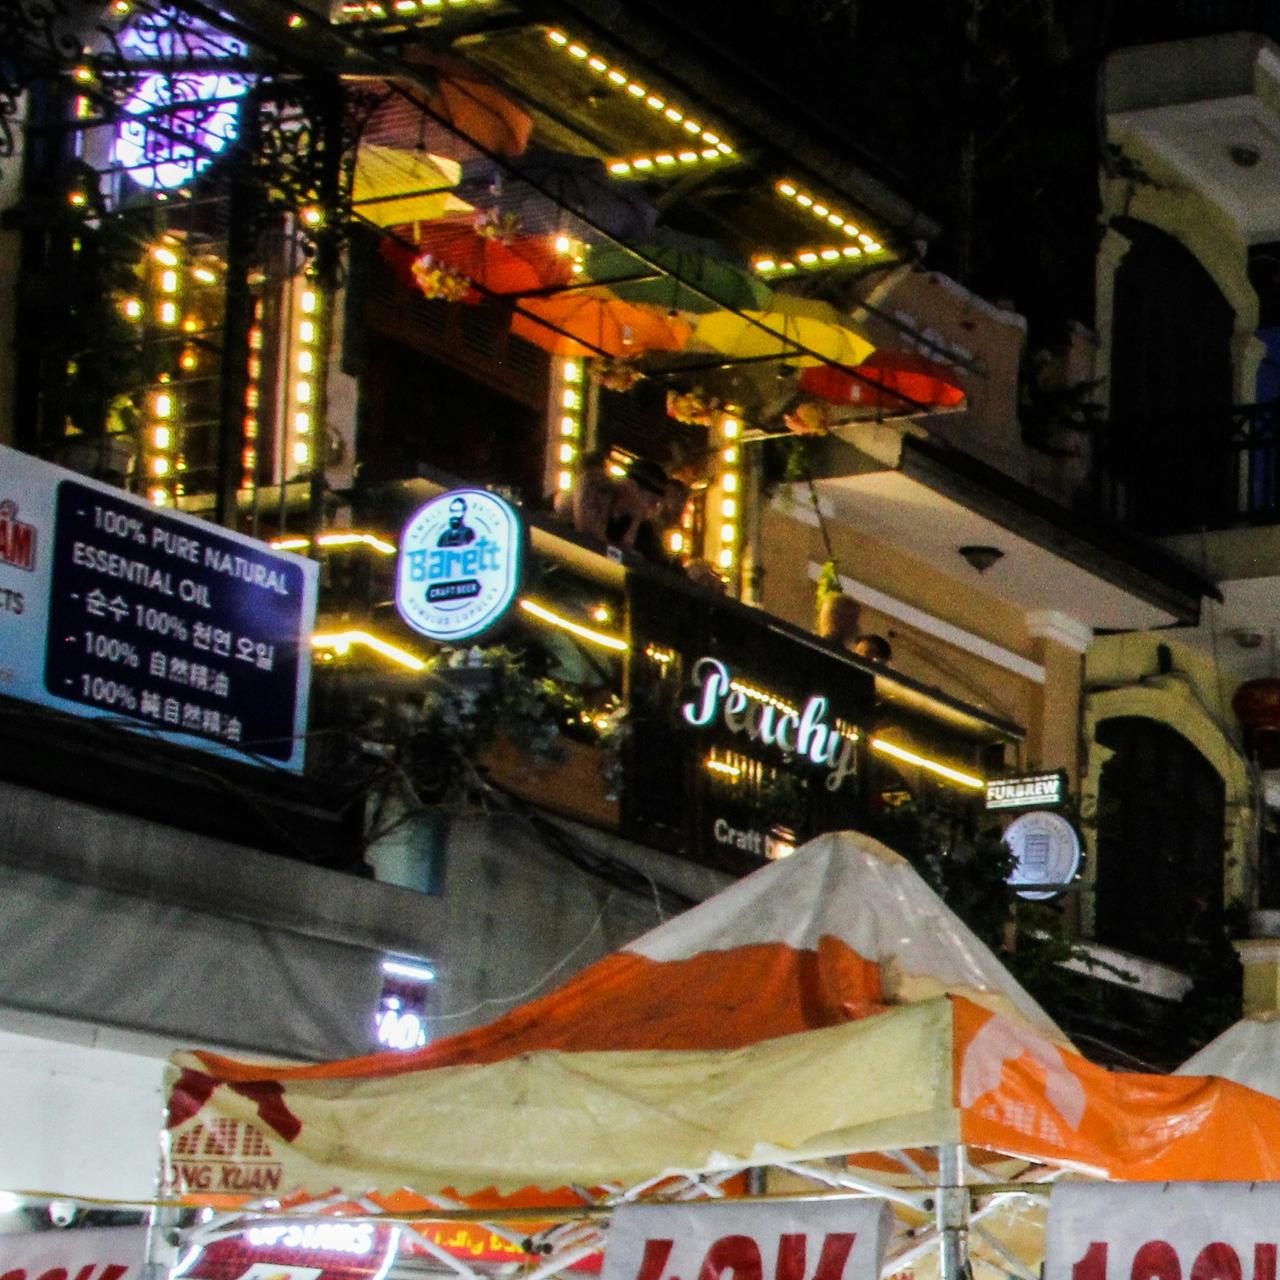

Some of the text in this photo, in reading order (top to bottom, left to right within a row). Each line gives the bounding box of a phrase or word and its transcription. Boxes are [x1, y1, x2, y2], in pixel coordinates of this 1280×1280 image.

[94, 506, 289, 595] 100% PURE NATURAL
[406, 536, 501, 581] Barett
[72, 541, 211, 608] ESSENTIAL OIL
[85, 631, 139, 668] 100%
[86, 587, 130, 622] 순수
[135, 604, 188, 641] 100%
[235, 637, 274, 671] 오일
[81, 673, 137, 710] 100%
[683, 657, 858, 791] Peachy
[987, 780, 1059, 800] FURBREW
[714, 819, 761, 855] Craft
